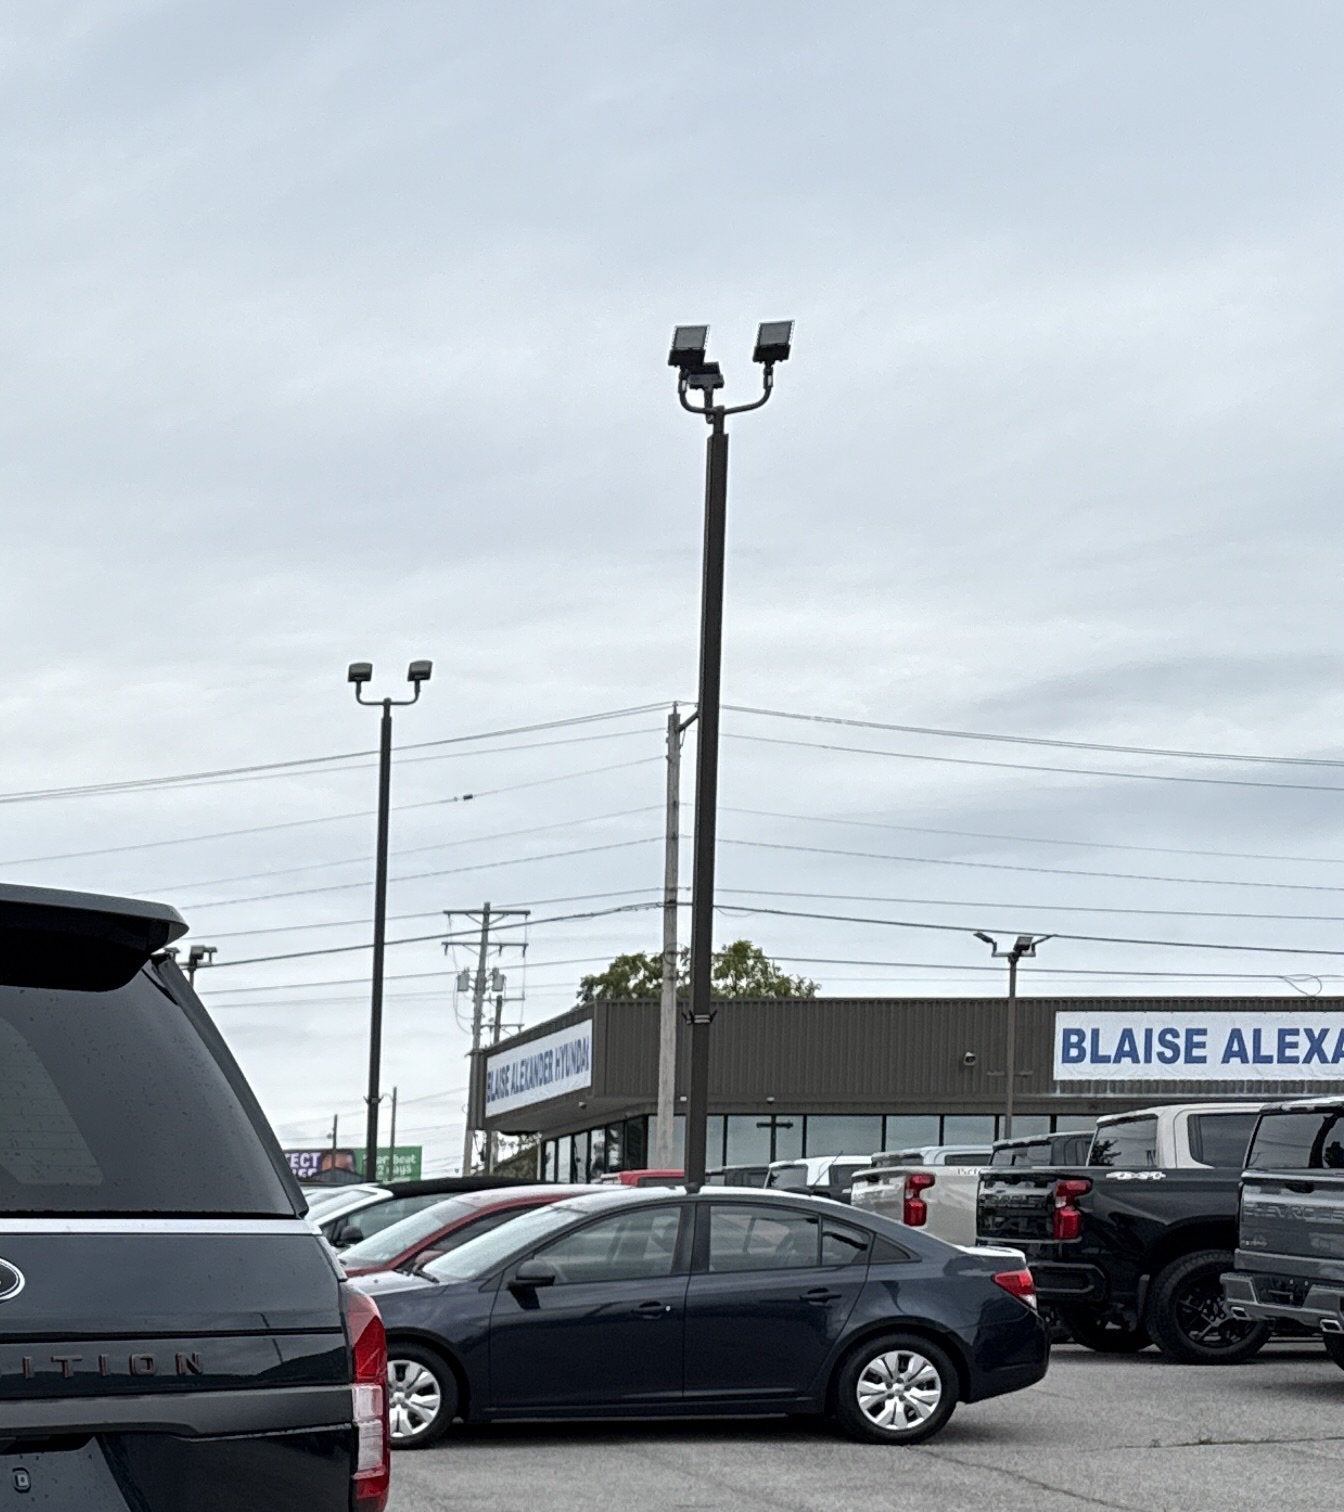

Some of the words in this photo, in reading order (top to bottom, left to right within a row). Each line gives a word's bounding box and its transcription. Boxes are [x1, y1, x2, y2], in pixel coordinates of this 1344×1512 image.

[486, 1065, 510, 1103] BLAISE
[511, 1049, 553, 1095] ALEXANDER
[555, 1036, 589, 1081] HYUNDAI
[1061, 1027, 1208, 1064] BLAISE
